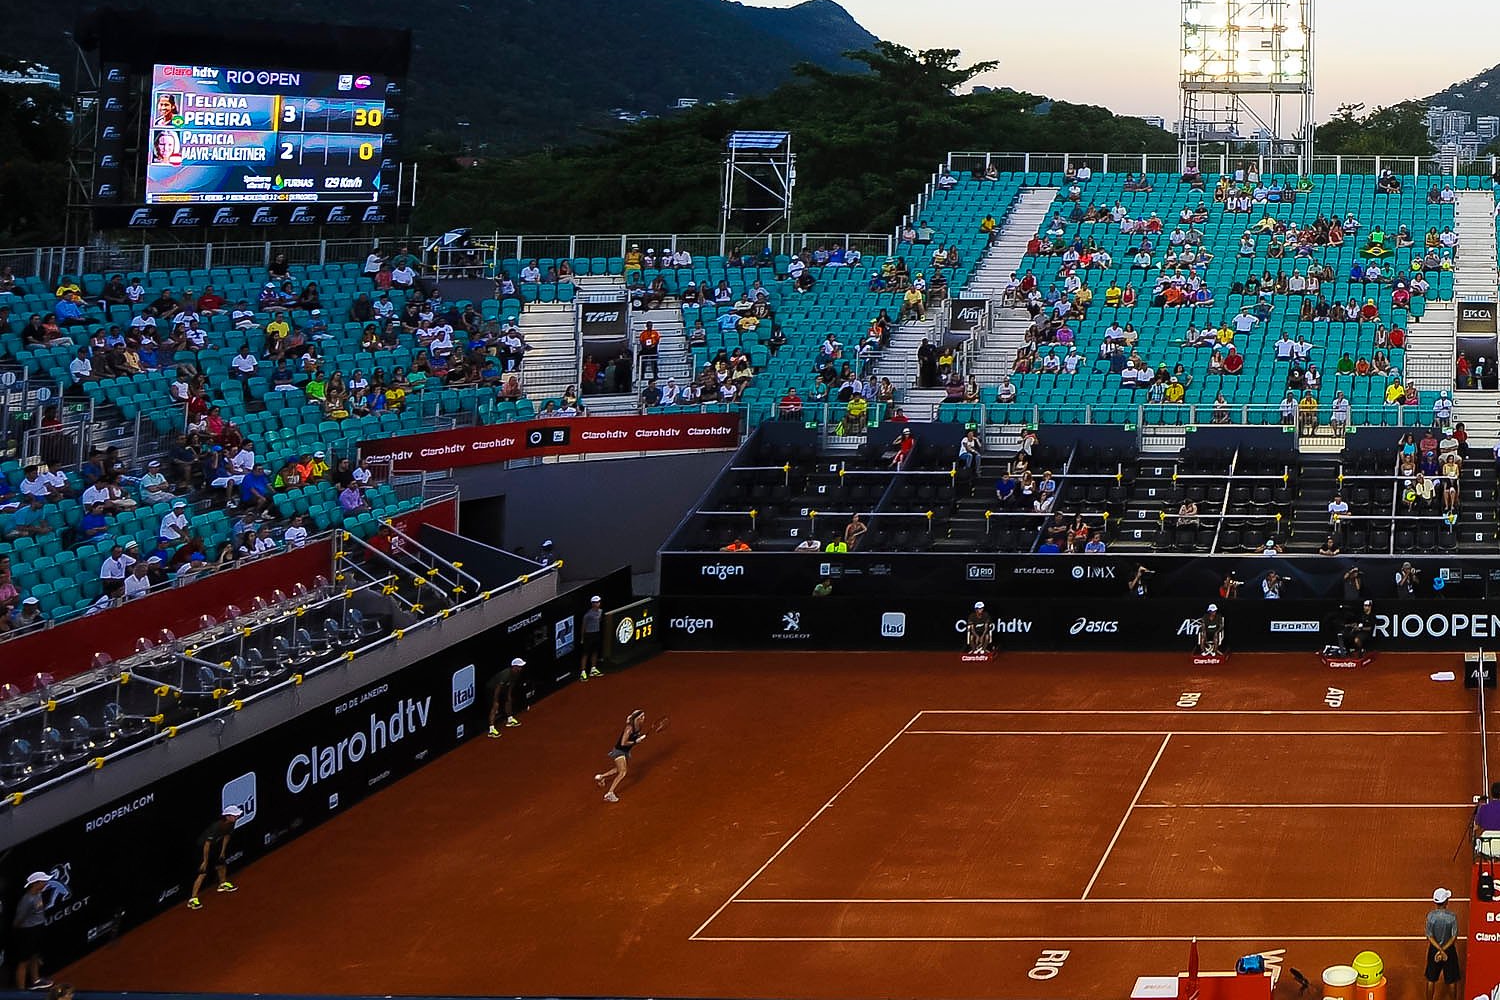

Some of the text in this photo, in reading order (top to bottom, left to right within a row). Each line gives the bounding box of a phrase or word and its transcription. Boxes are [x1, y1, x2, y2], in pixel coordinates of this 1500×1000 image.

[227, 71, 300, 85] RIO OPEN
[185, 93, 248, 108] TELIANA
[185, 112, 251, 126] PEREIRA
[283, 105, 296, 122] 3
[354, 108, 382, 126] 30
[183, 131, 234, 145] PATRICIA
[182, 146, 266, 161] MAYR-ACHLEITNER
[280, 143, 293, 159] 2
[359, 143, 373, 160] 0
[325, 177, 340, 188] 129
[585, 312, 619, 322] TAM
[701, 563, 744, 580] raízen
[1013, 566, 1055, 574] artefacto
[1087, 566, 1116, 578] IMX
[670, 615, 713, 633] raízen
[1085, 618, 1118, 633] asics
[335, 683, 388, 716] RIO DE JANEIRO
[453, 683, 474, 707] Itaú
[1176, 692, 1201, 708] RIO
[1324, 686, 1345, 708] ATP
[286, 695, 432, 794] Clarohdtv
[86, 792, 155, 833] RIOOPEN.COM
[44, 896, 90, 927] UGEOT
[1027, 949, 1071, 980] RIO
